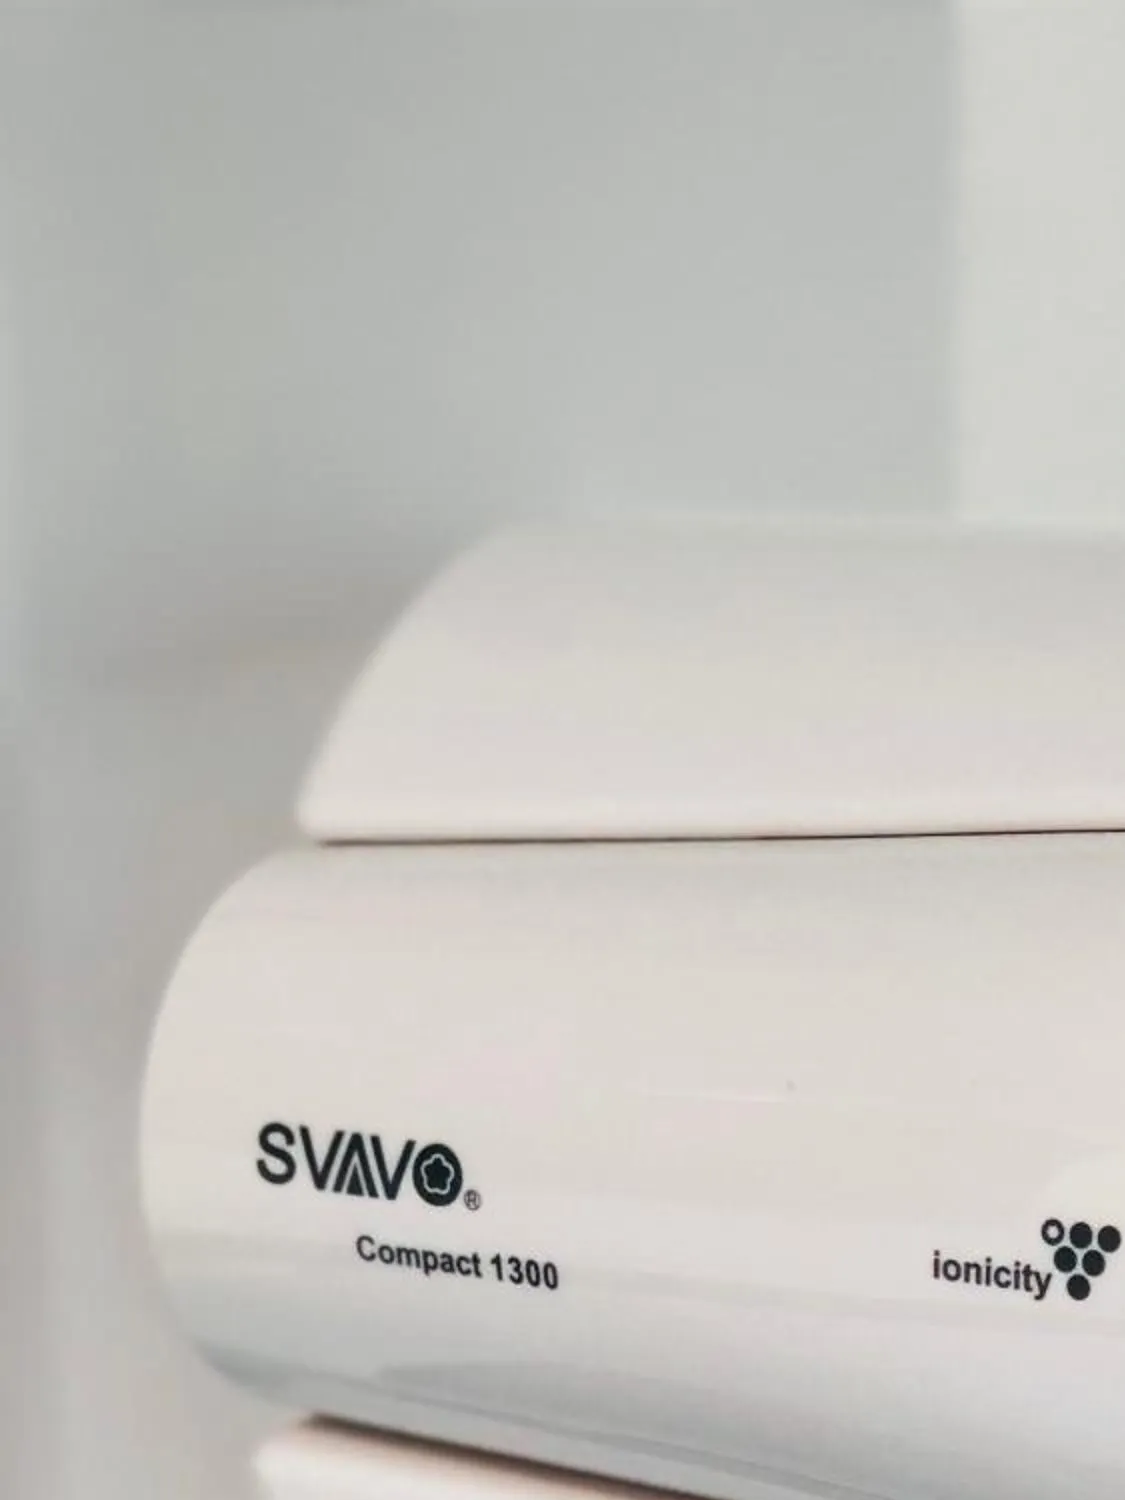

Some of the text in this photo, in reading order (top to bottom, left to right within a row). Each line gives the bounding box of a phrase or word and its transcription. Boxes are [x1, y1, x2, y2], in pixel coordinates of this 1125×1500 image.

[355, 1234, 559, 1290] Compact 1300
[932, 1249, 1052, 1301] ionicity
